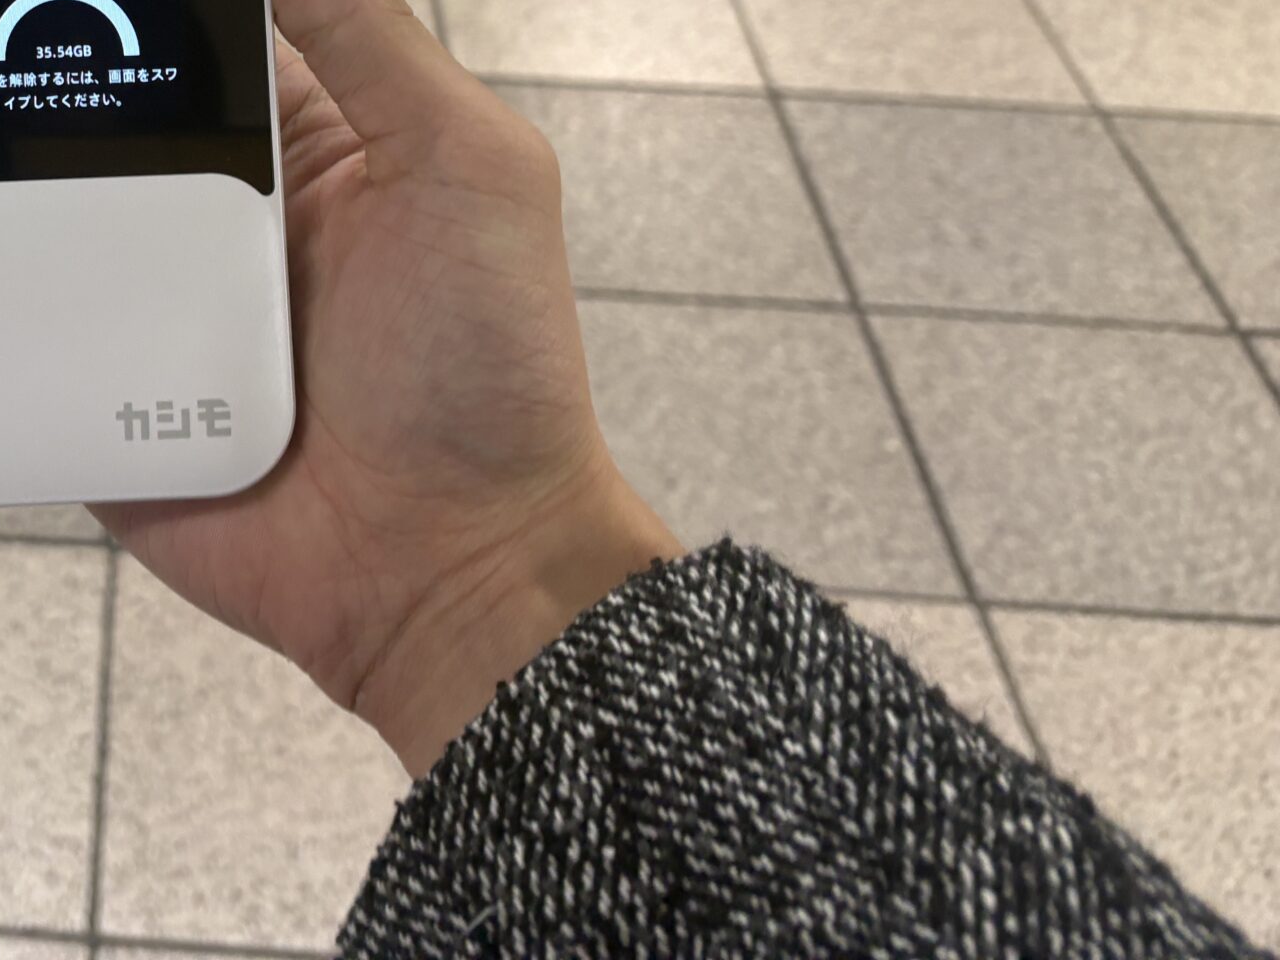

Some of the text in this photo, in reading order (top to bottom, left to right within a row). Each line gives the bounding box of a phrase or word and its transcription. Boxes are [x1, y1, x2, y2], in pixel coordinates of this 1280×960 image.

[36, 45, 92, 59] 35.54GB
[116, 398, 232, 441] カシモ
